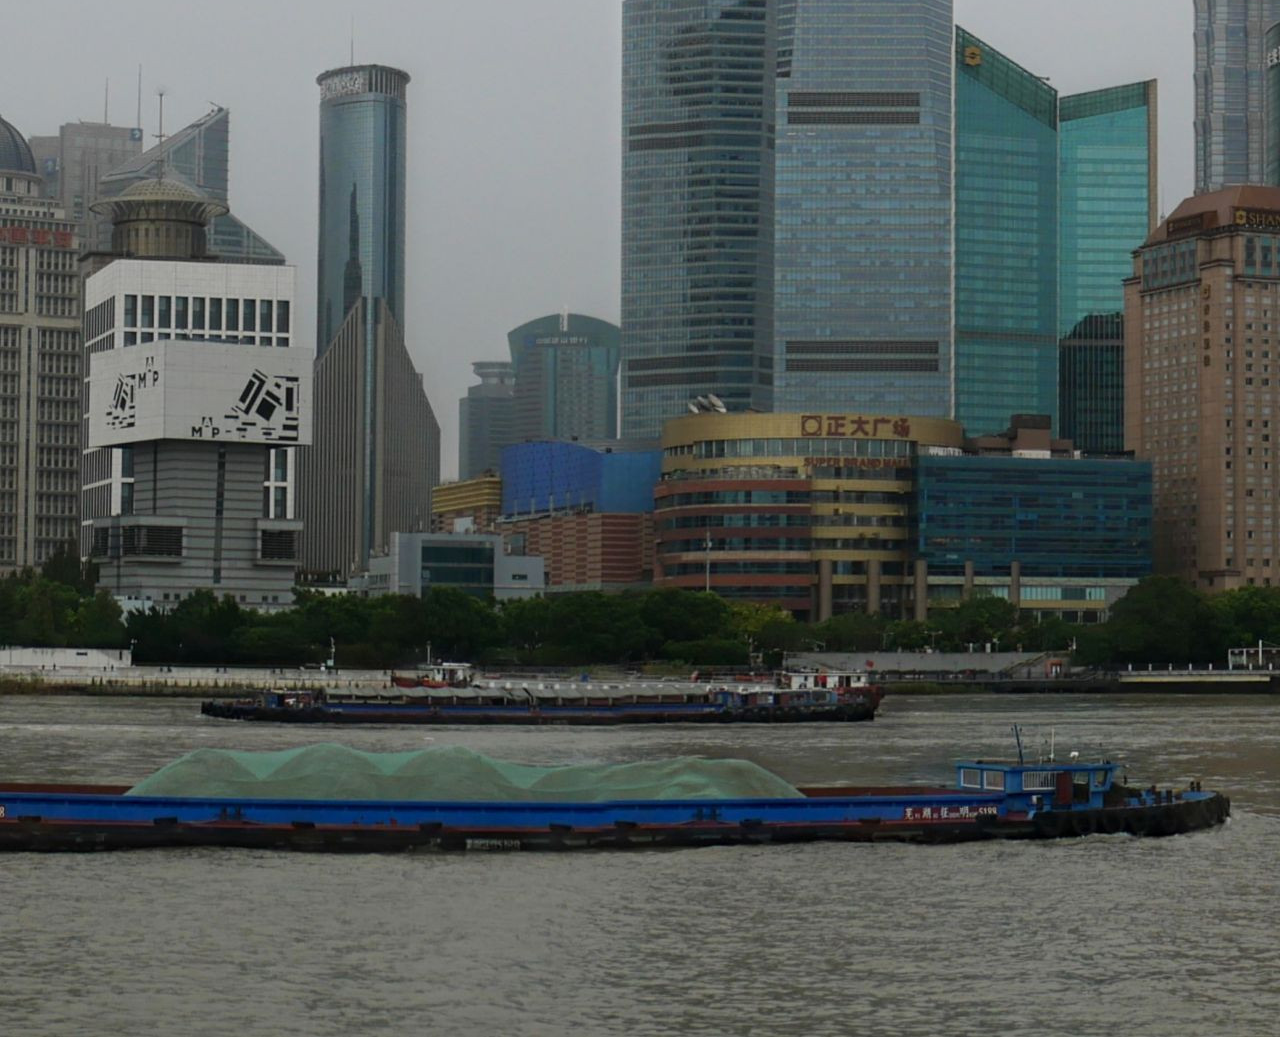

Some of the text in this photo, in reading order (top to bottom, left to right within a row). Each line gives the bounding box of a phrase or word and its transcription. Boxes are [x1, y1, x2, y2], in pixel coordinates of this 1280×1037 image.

[826, 416, 910, 437] 正大广场
[804, 457, 840, 467] SUPER
[844, 457, 881, 468] BRAND
